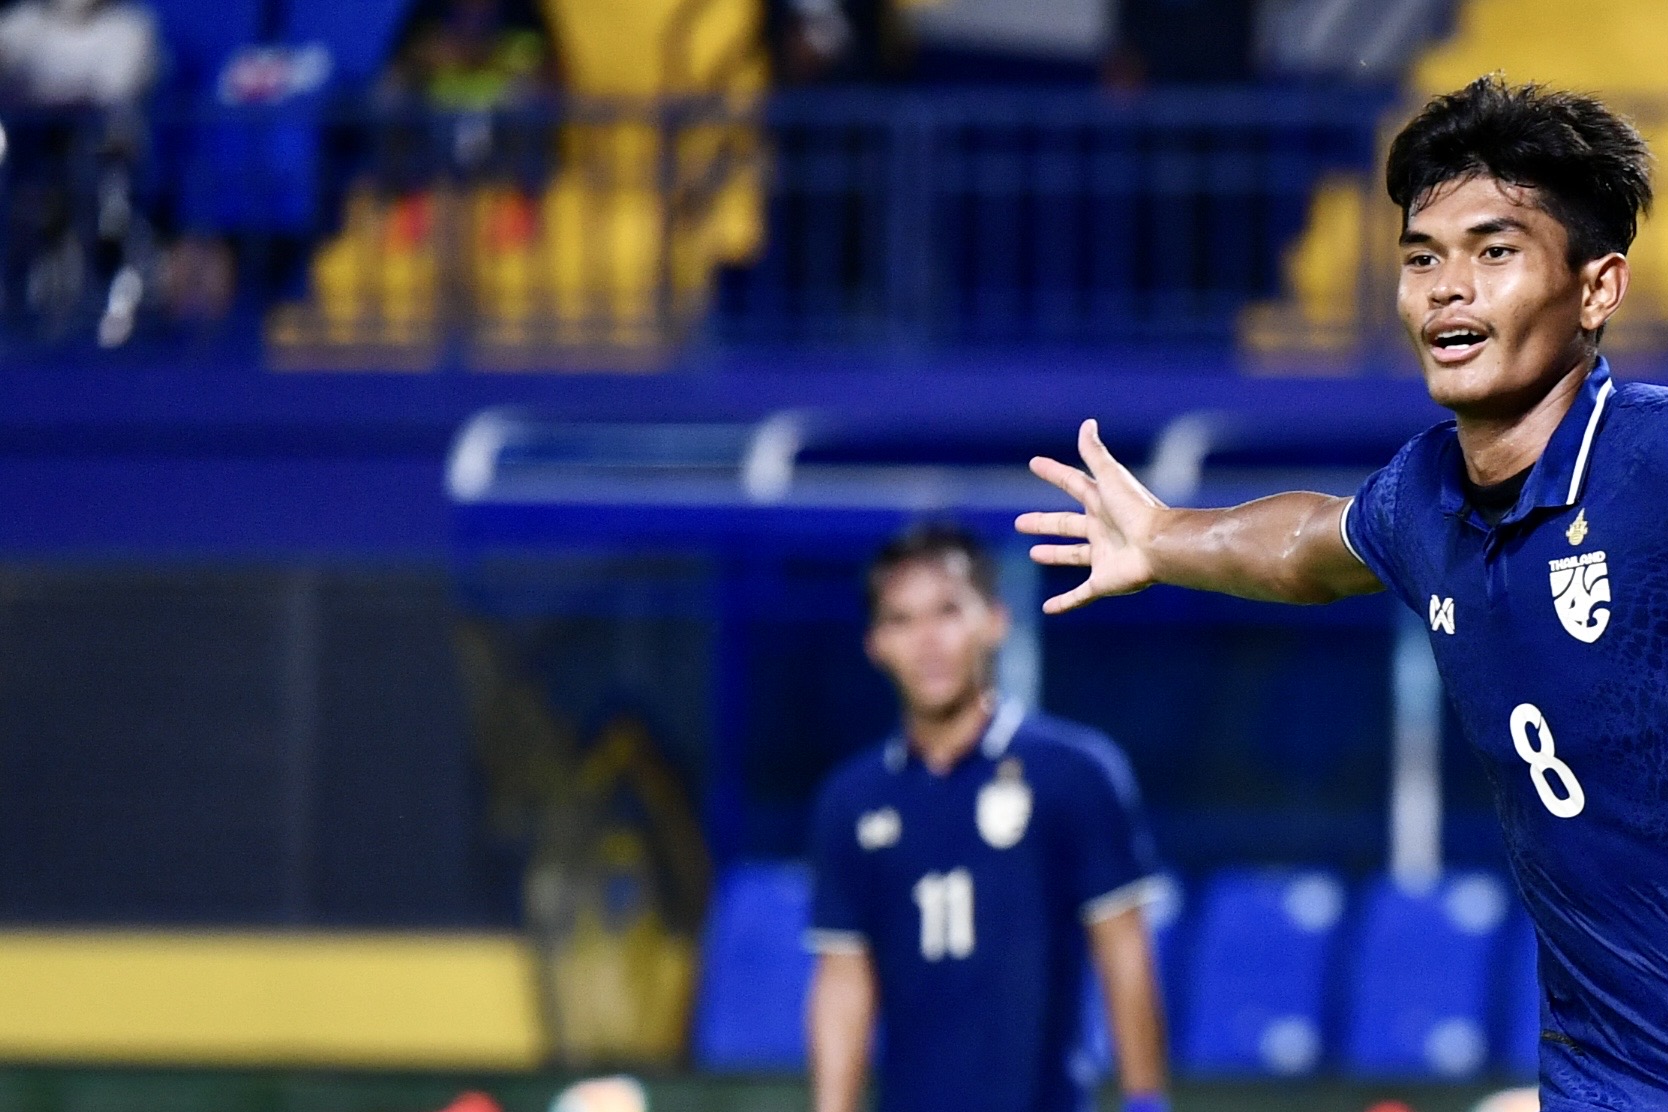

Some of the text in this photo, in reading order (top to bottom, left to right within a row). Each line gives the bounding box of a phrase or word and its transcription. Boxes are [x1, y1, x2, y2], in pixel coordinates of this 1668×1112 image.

[1548, 551, 1607, 571] THAILAND
[1509, 702, 1586, 819] 8
[912, 866, 975, 963] 11
